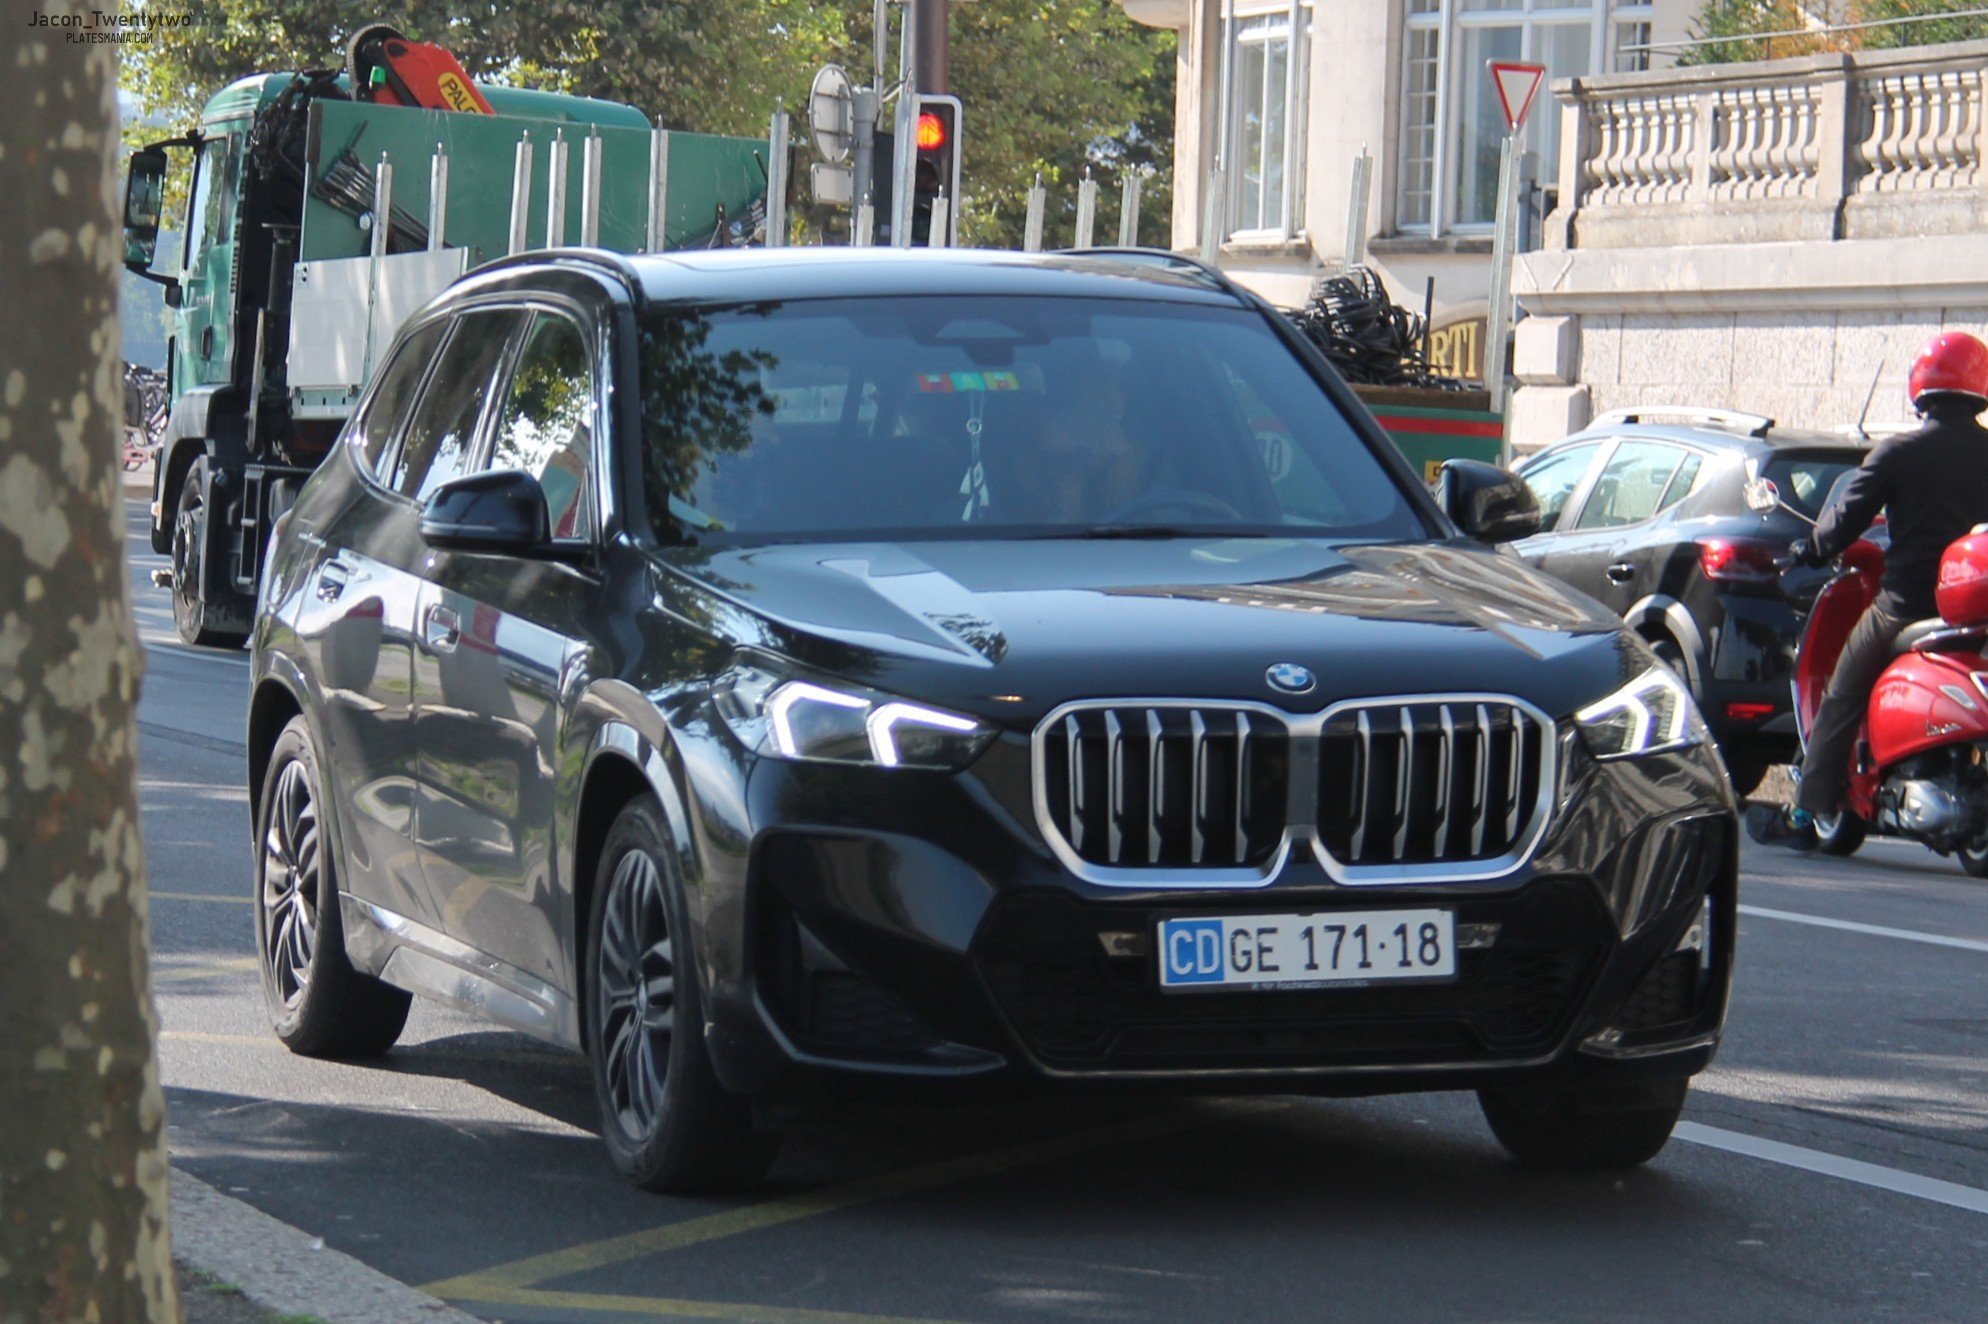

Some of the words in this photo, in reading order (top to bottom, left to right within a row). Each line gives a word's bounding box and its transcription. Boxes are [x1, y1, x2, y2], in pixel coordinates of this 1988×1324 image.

[1414, 321, 1478, 377] RTI
[1168, 928, 1221, 976] CD
[1229, 926, 1279, 973] GE
